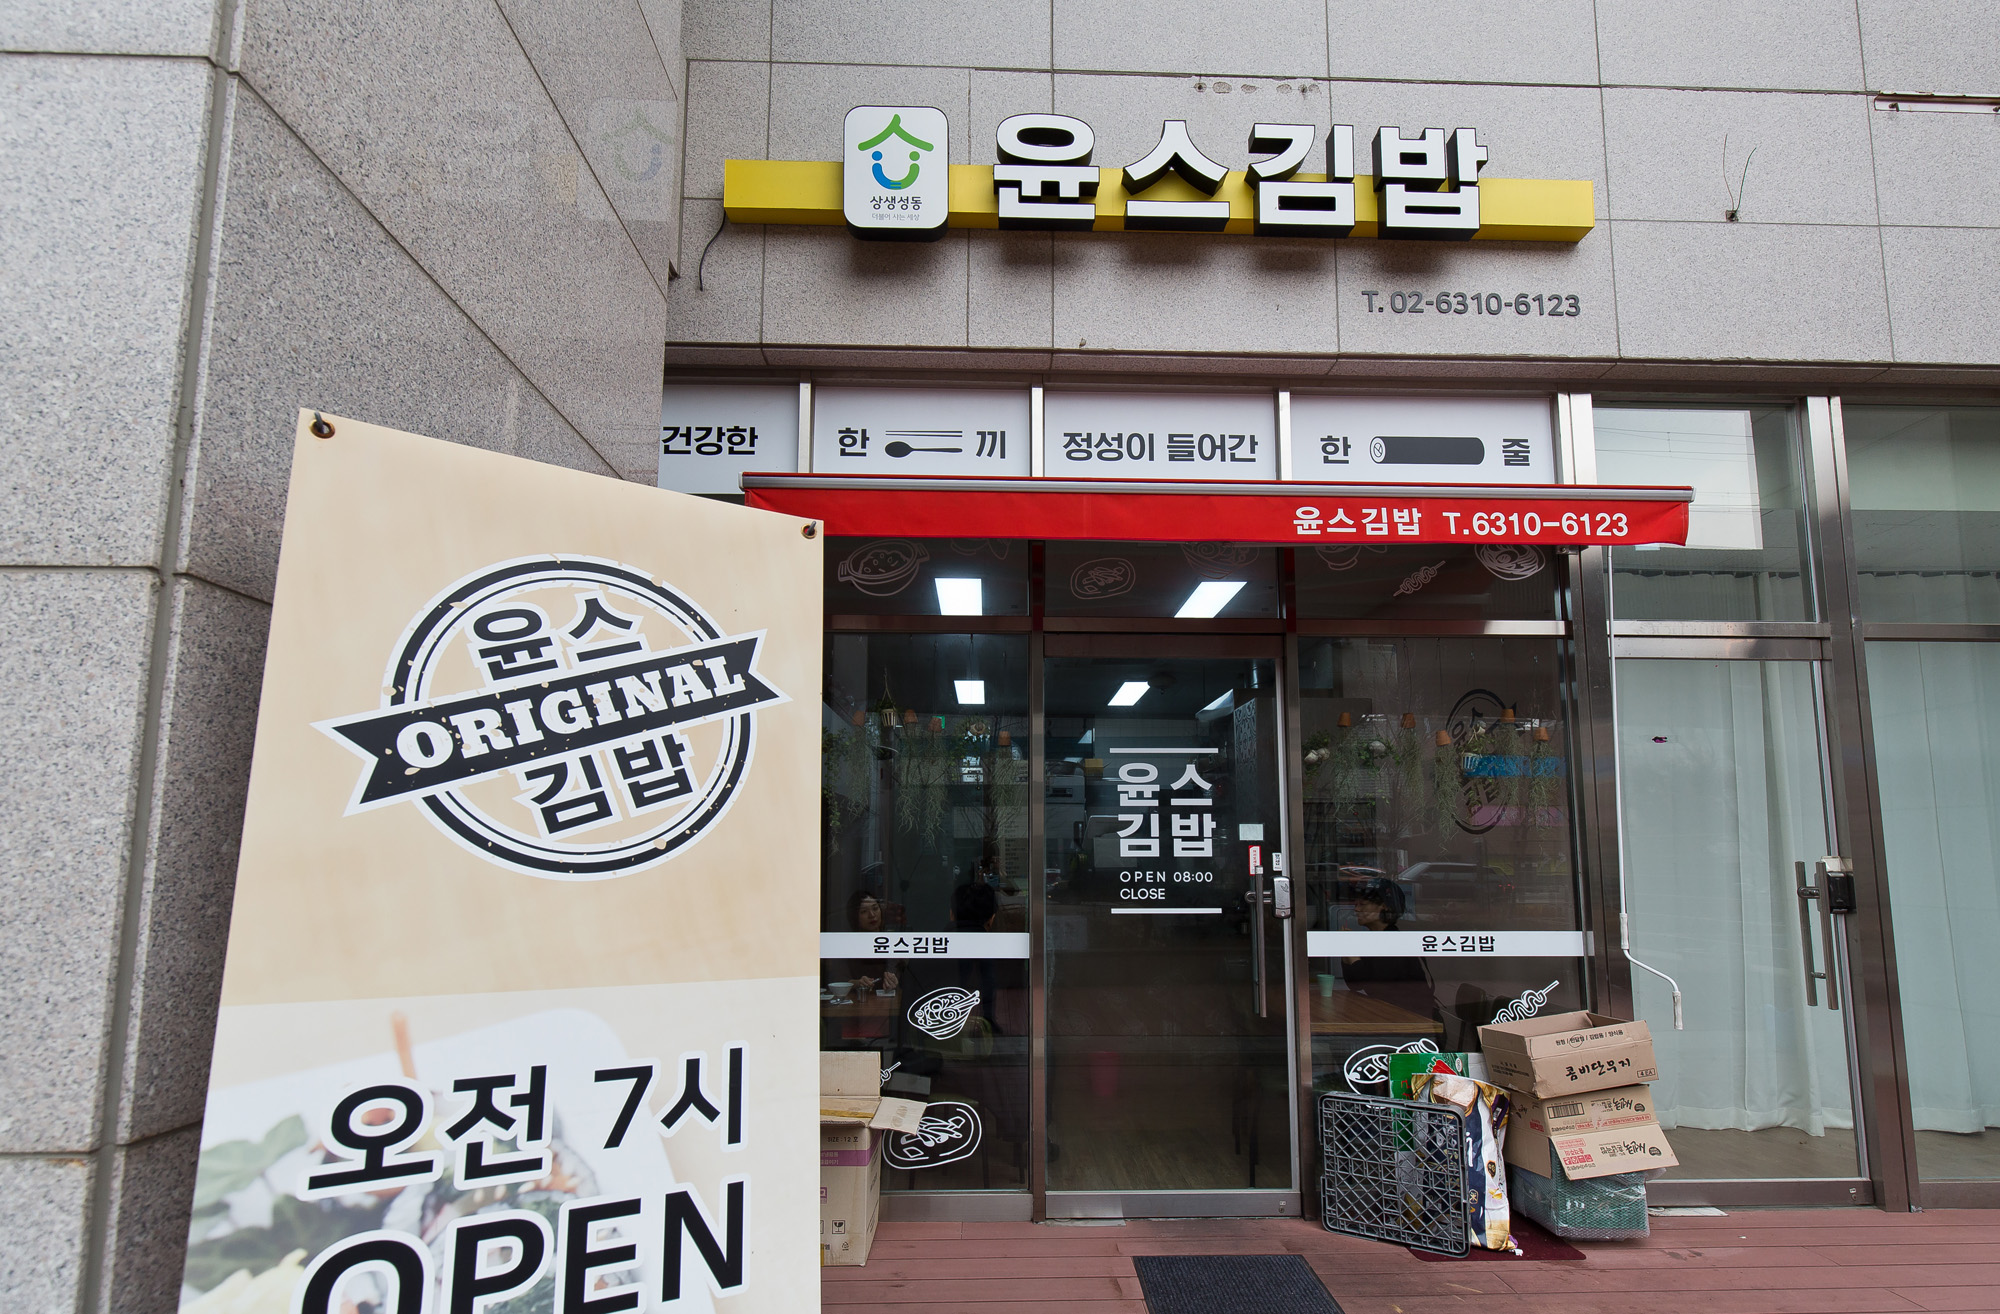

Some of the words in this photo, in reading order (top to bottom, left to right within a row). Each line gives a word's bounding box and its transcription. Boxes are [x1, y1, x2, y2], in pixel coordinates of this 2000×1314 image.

[992, 112, 1489, 233] 윤스김밥
[869, 196, 923, 211] 상생성동
[871, 213, 891, 221] 더불어
[892, 213, 905, 221] 사는
[907, 213, 921, 221] 세상
[1391, 290, 1582, 317] 02-6310-6123
[661, 425, 759, 456] 건강한
[838, 427, 870, 458] 한
[975, 430, 1007, 460] 끼
[1062, 432, 1155, 464] 정성이
[1167, 433, 1259, 464] 들어간
[1319, 434, 1352, 465] 한
[1501, 438, 1531, 468] 줄
[1292, 505, 1422, 537] 윤스김밥
[1443, 511, 1629, 537] T.6310-6123
[472, 597, 644, 682] 윤스
[396, 656, 747, 769] ORIGINAL
[523, 733, 694, 836] 김밥
[1117, 762, 1213, 807] 윤스
[1116, 813, 1217, 858] 김밥
[1119, 871, 1166, 883] OPEN
[1173, 871, 1213, 883] 08:00
[1119, 888, 1166, 900] CLOSE
[873, 936, 950, 954] 윤스김밥
[1421, 934, 1496, 953] 윤스김밥
[1565, 1057, 1631, 1081] 콤비단무지
[307, 1064, 549, 1191] 오전
[592, 1046, 744, 1149] 7시
[298, 1180, 746, 1314] OPEN
